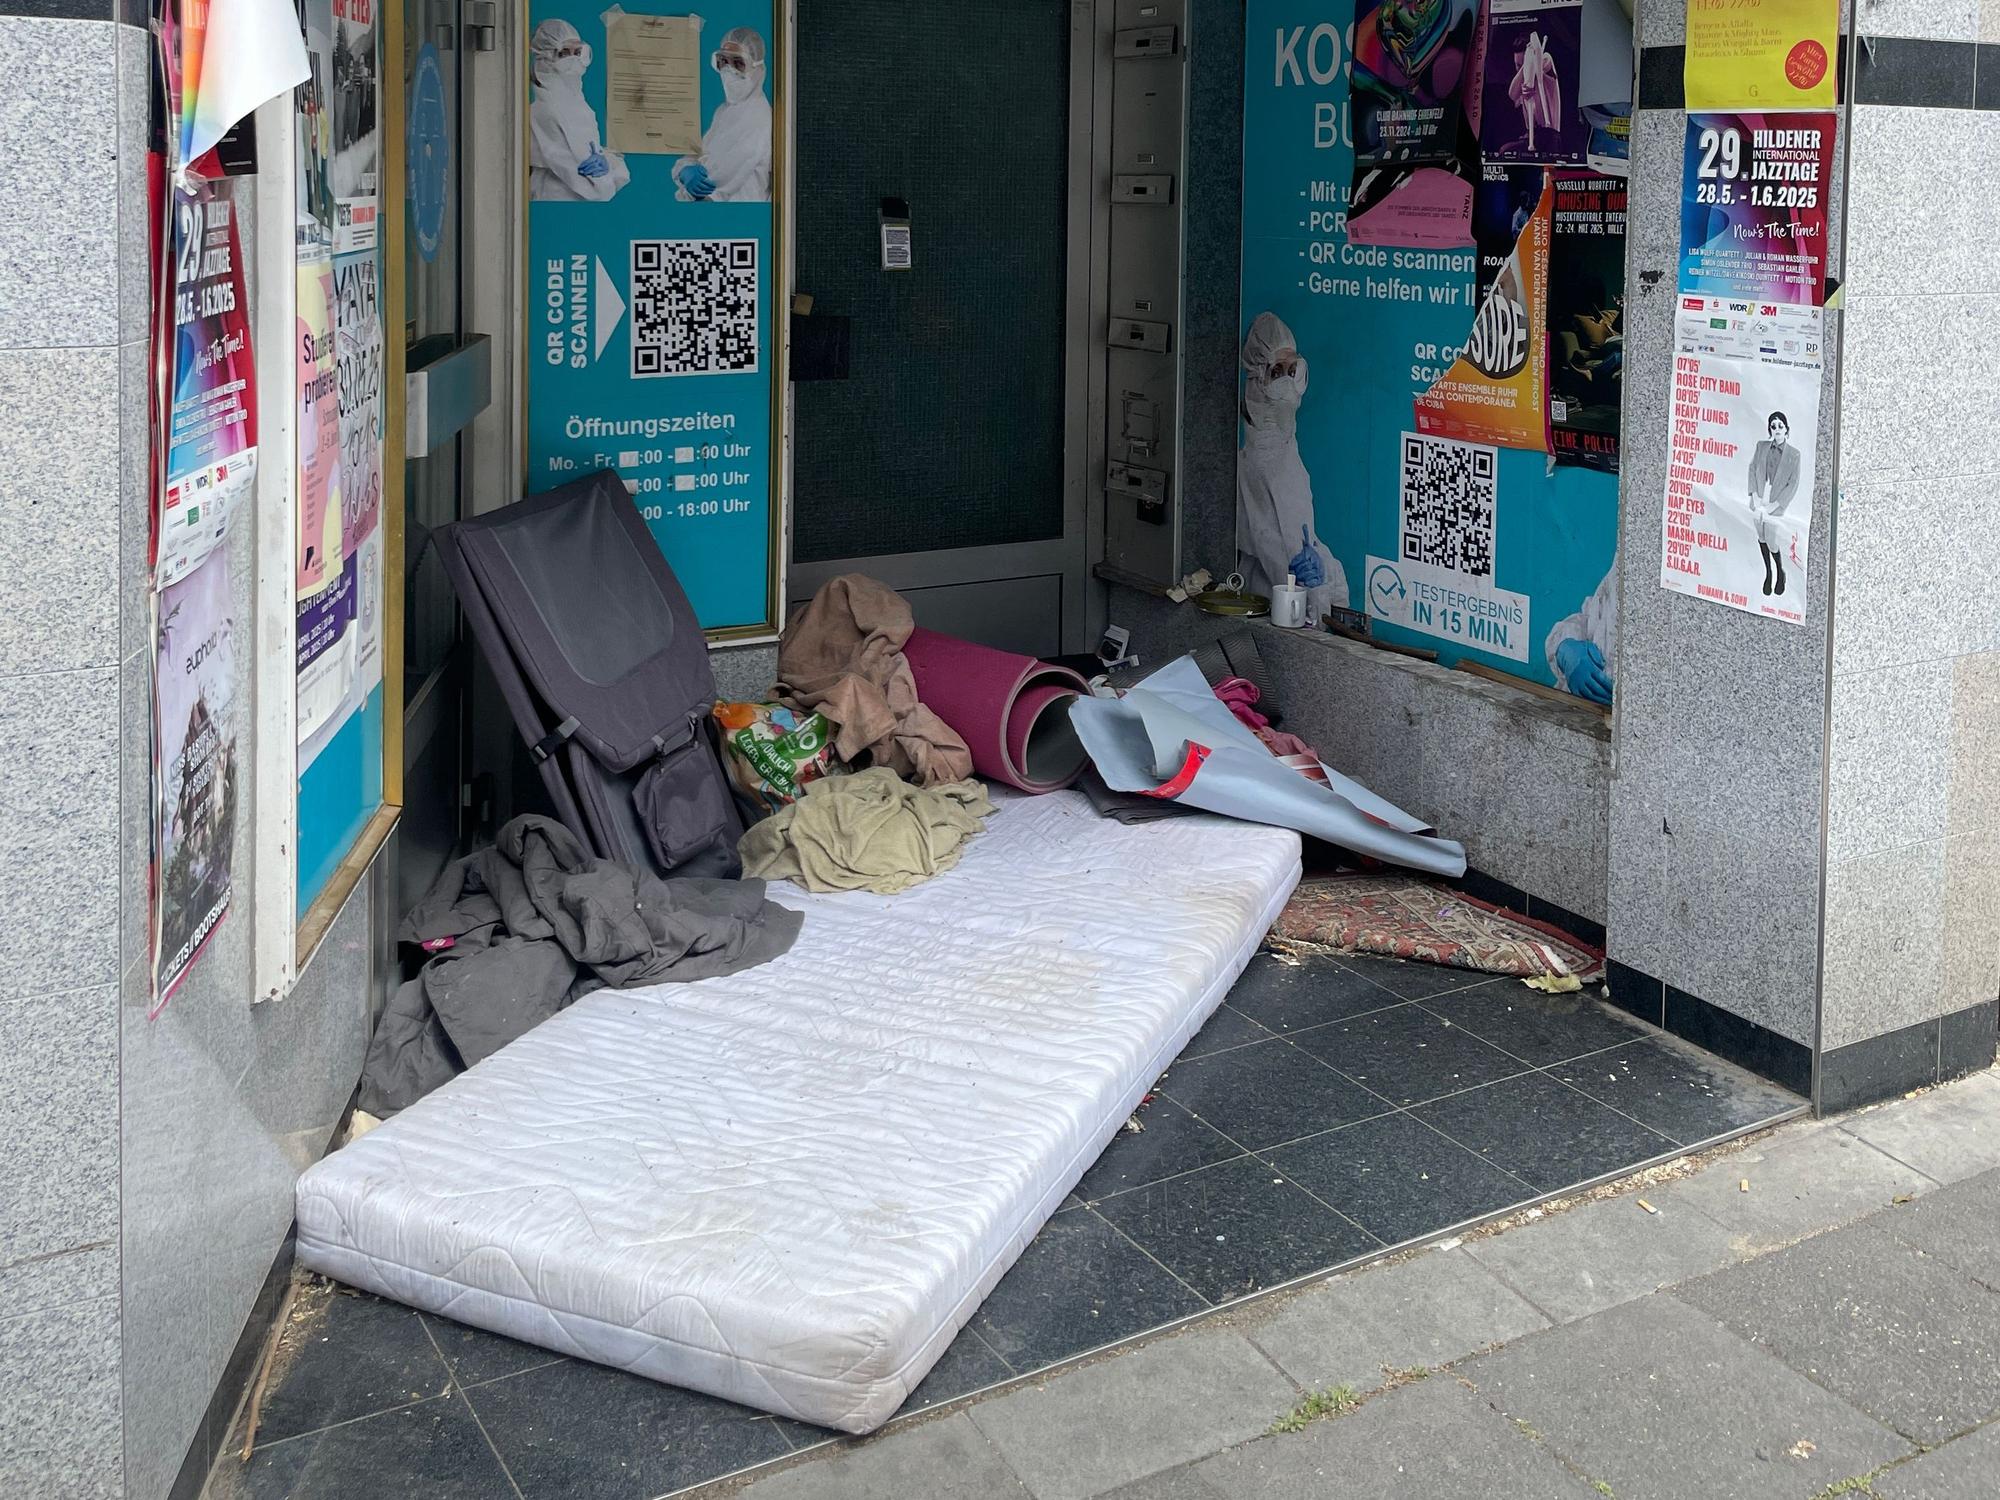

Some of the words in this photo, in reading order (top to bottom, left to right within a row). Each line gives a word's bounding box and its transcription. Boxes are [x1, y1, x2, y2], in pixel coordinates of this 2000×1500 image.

[1274, 22, 1352, 88] KO
[1391, 109, 1417, 121] BAHNHOF
[1379, 125, 1410, 138] 23.11.2024
[1753, 129, 1821, 149] HILDENER
[1698, 127, 1749, 181] 29.
[1752, 150, 1820, 161] INTERNATIONAL
[1483, 166, 1504, 174] MULTI
[1751, 161, 1819, 181] JAZZTAGE
[1310, 181, 1336, 202] Mit
[1588, 180, 1616, 191] QUARTETT
[1696, 183, 1735, 205] 28.5.
[1750, 185, 1818, 209] 1.6.2025
[1462, 193, 1471, 220] TANZ
[1309, 211, 1347, 233] PCR
[1533, 216, 1541, 246] HANS
[1540, 216, 1548, 246] JULIO
[1578, 223, 1588, 234] MAI
[1733, 223, 1764, 241] Now's
[1764, 221, 1787, 239] The
[1786, 221, 1820, 239] Time!
[1309, 242, 1335, 266] QR
[1341, 243, 1386, 267] Code
[1391, 251, 1476, 273] scannen
[1533, 249, 1541, 273] VAN
[1757, 262, 1785, 272] SEBASTIAN
[547, 258, 564, 325] CODE
[1308, 271, 1360, 298] Gerne
[1366, 274, 1422, 303] helfen
[1428, 283, 1461, 304] wir
[1533, 274, 1541, 294] DEN
[202, 282, 235, 318] 1.6.2025
[1729, 303, 1747, 312] WDR
[1760, 305, 1777, 317] 3M
[570, 254, 588, 369] SCANNEN
[1533, 298, 1541, 341] BROECK
[1463, 294, 1527, 373] SURE
[547, 330, 564, 366] QR
[1414, 342, 1436, 361] QR
[1411, 365, 1449, 384] SCA
[1676, 373, 1698, 389] ROSE
[1699, 376, 1717, 392] CITY
[1719, 380, 1741, 396] BAND
[1425, 390, 1445, 401] ANZA
[1458, 383, 1496, 396] ENSEMBLE
[1497, 386, 1518, 398] RUHR
[1425, 399, 1445, 410] CUBA
[1675, 403, 1701, 421] HEAVY
[1702, 408, 1729, 426] LUNGS
[565, 411, 736, 439] Öffnungszeiten
[1673, 432, 1701, 452] GÜNER
[549, 455, 578, 472] Mo.
[595, 453, 615, 468] Fr.
[723, 444, 751, 458] Uhr
[216, 465, 229, 482] 3M
[722, 472, 750, 486] Uhr
[1670, 464, 1715, 486] EUROEURO
[677, 501, 718, 518] 18:00
[722, 499, 750, 514] Uhr
[1667, 494, 1685, 512] NAP
[1686, 498, 1705, 516] EYES
[1667, 525, 1696, 544] MASHA
[1697, 531, 1728, 553] QRELLA
[1666, 555, 1701, 576] S.U.G.A.R.
[1412, 581, 1523, 625] TESTERGEBNIS
[1697, 583, 1723, 602] BUMANN
[1724, 592, 1730, 603] &
[1730, 593, 1748, 607] SOHN
[1413, 600, 1432, 626] IN
[1440, 608, 1462, 634] 15
[1469, 616, 1514, 650] MIN.
[194, 885, 231, 949] BOOTSHAUS
